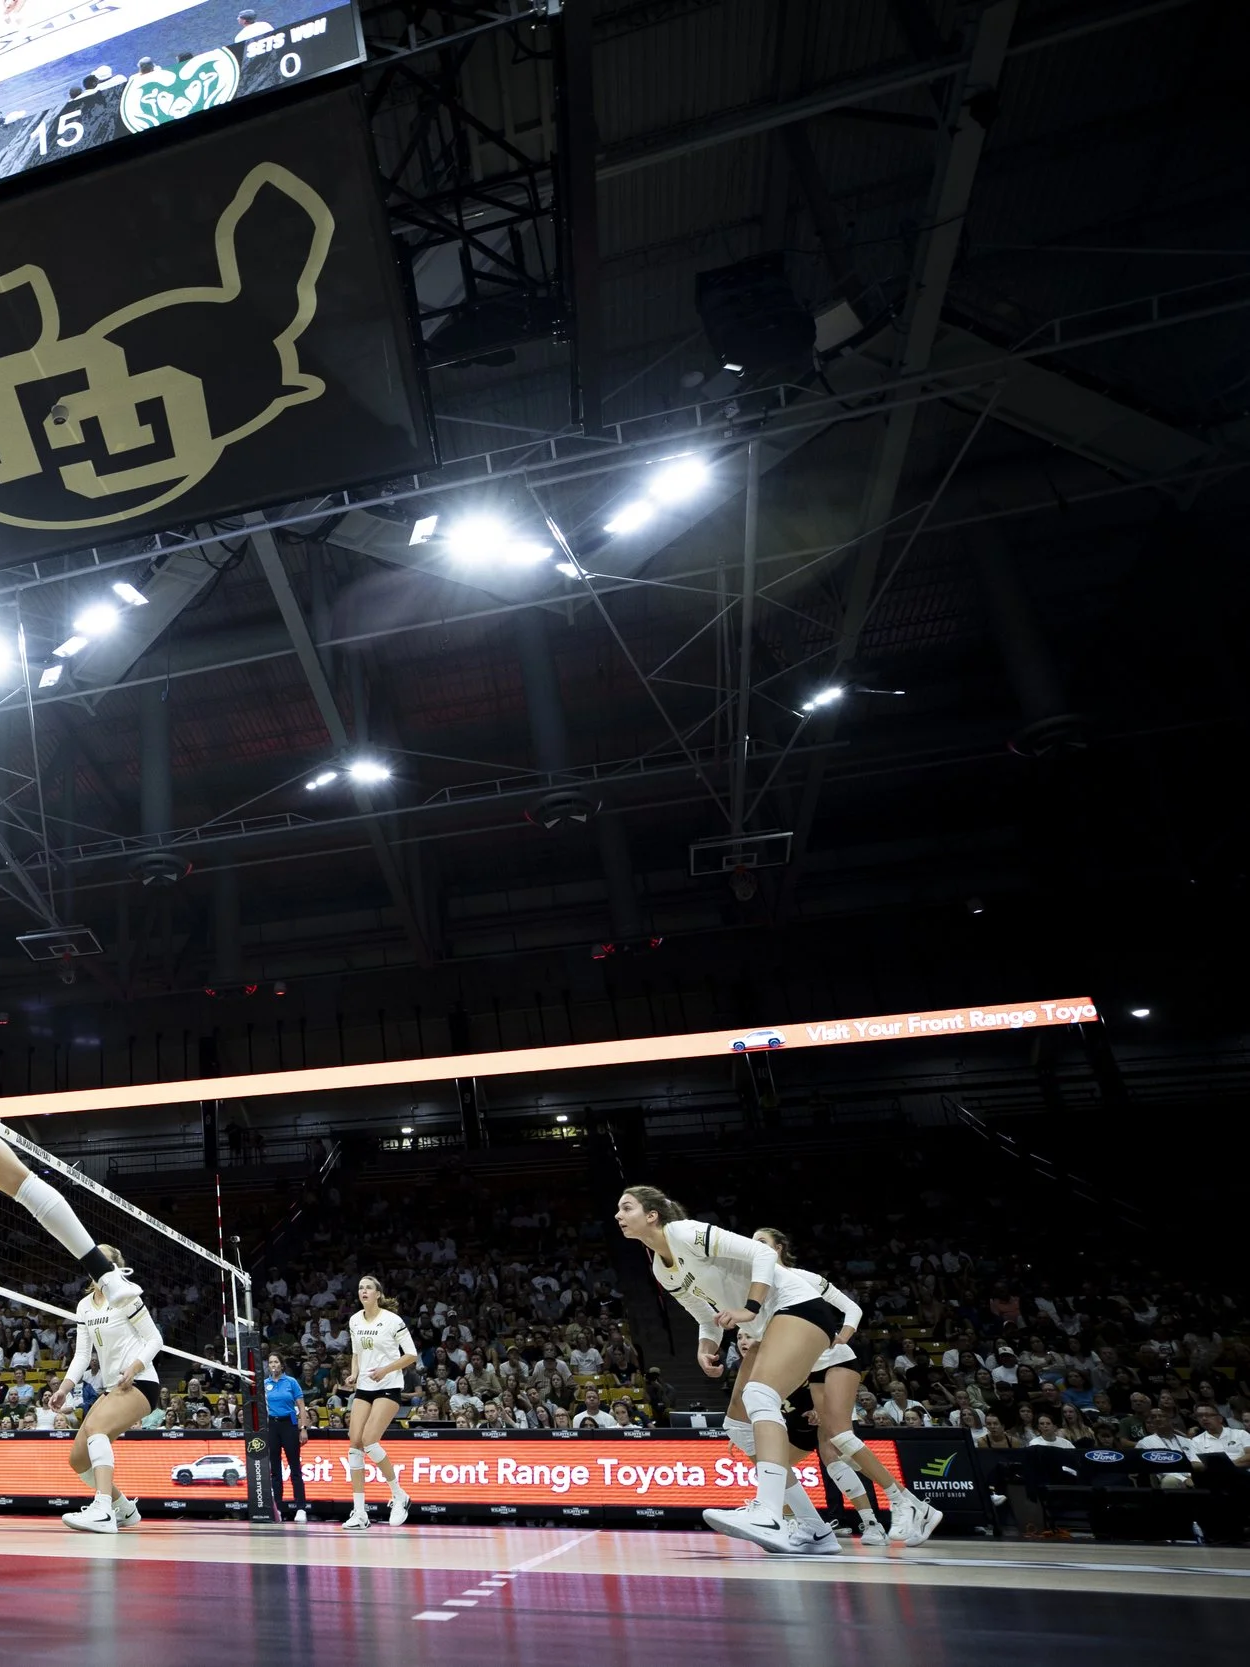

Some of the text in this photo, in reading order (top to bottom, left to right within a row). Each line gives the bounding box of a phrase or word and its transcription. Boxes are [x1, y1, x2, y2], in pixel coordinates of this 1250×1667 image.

[246, 17, 327, 57] SETS WON
[280, 52, 301, 78] 0
[30, 110, 84, 156] 15
[806, 1003, 1097, 1041] Visit Your Front Range Toyo
[88, 1316, 109, 1326] COLORADO
[95, 1328, 103, 1347] 1
[361, 1337, 374, 1350] 10
[1093, 1451, 1117, 1461] Ford
[1151, 1452, 1175, 1462] Ford
[413, 1457, 489, 1484] Front
[498, 1458, 590, 1493] Range
[597, 1458, 705, 1494] Toyota
[715, 1458, 819, 1487] Stoes
[913, 1481, 974, 1490] ELEVATIONS
